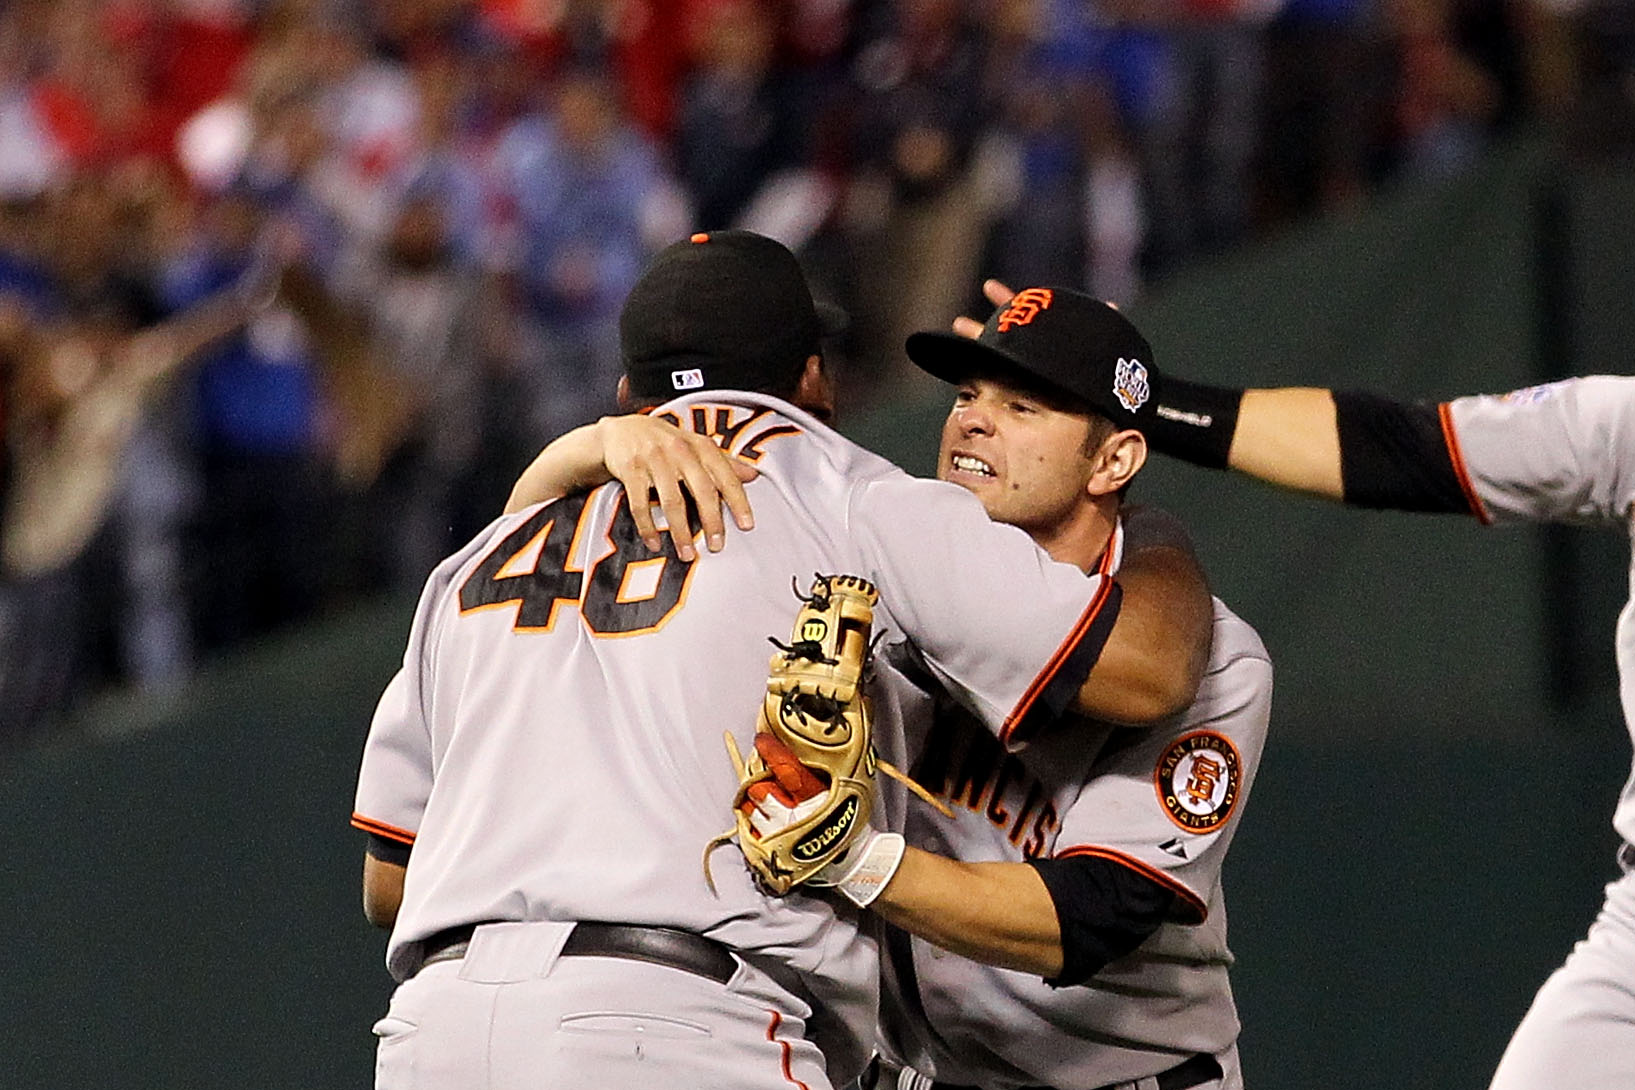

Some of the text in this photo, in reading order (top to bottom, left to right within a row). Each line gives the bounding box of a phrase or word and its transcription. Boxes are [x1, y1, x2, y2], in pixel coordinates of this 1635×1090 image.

[457, 487, 706, 640] 48
[1162, 745, 1185, 780] SAN
[797, 800, 855, 857] Wilson
[1165, 795, 1220, 827] GIANTS
